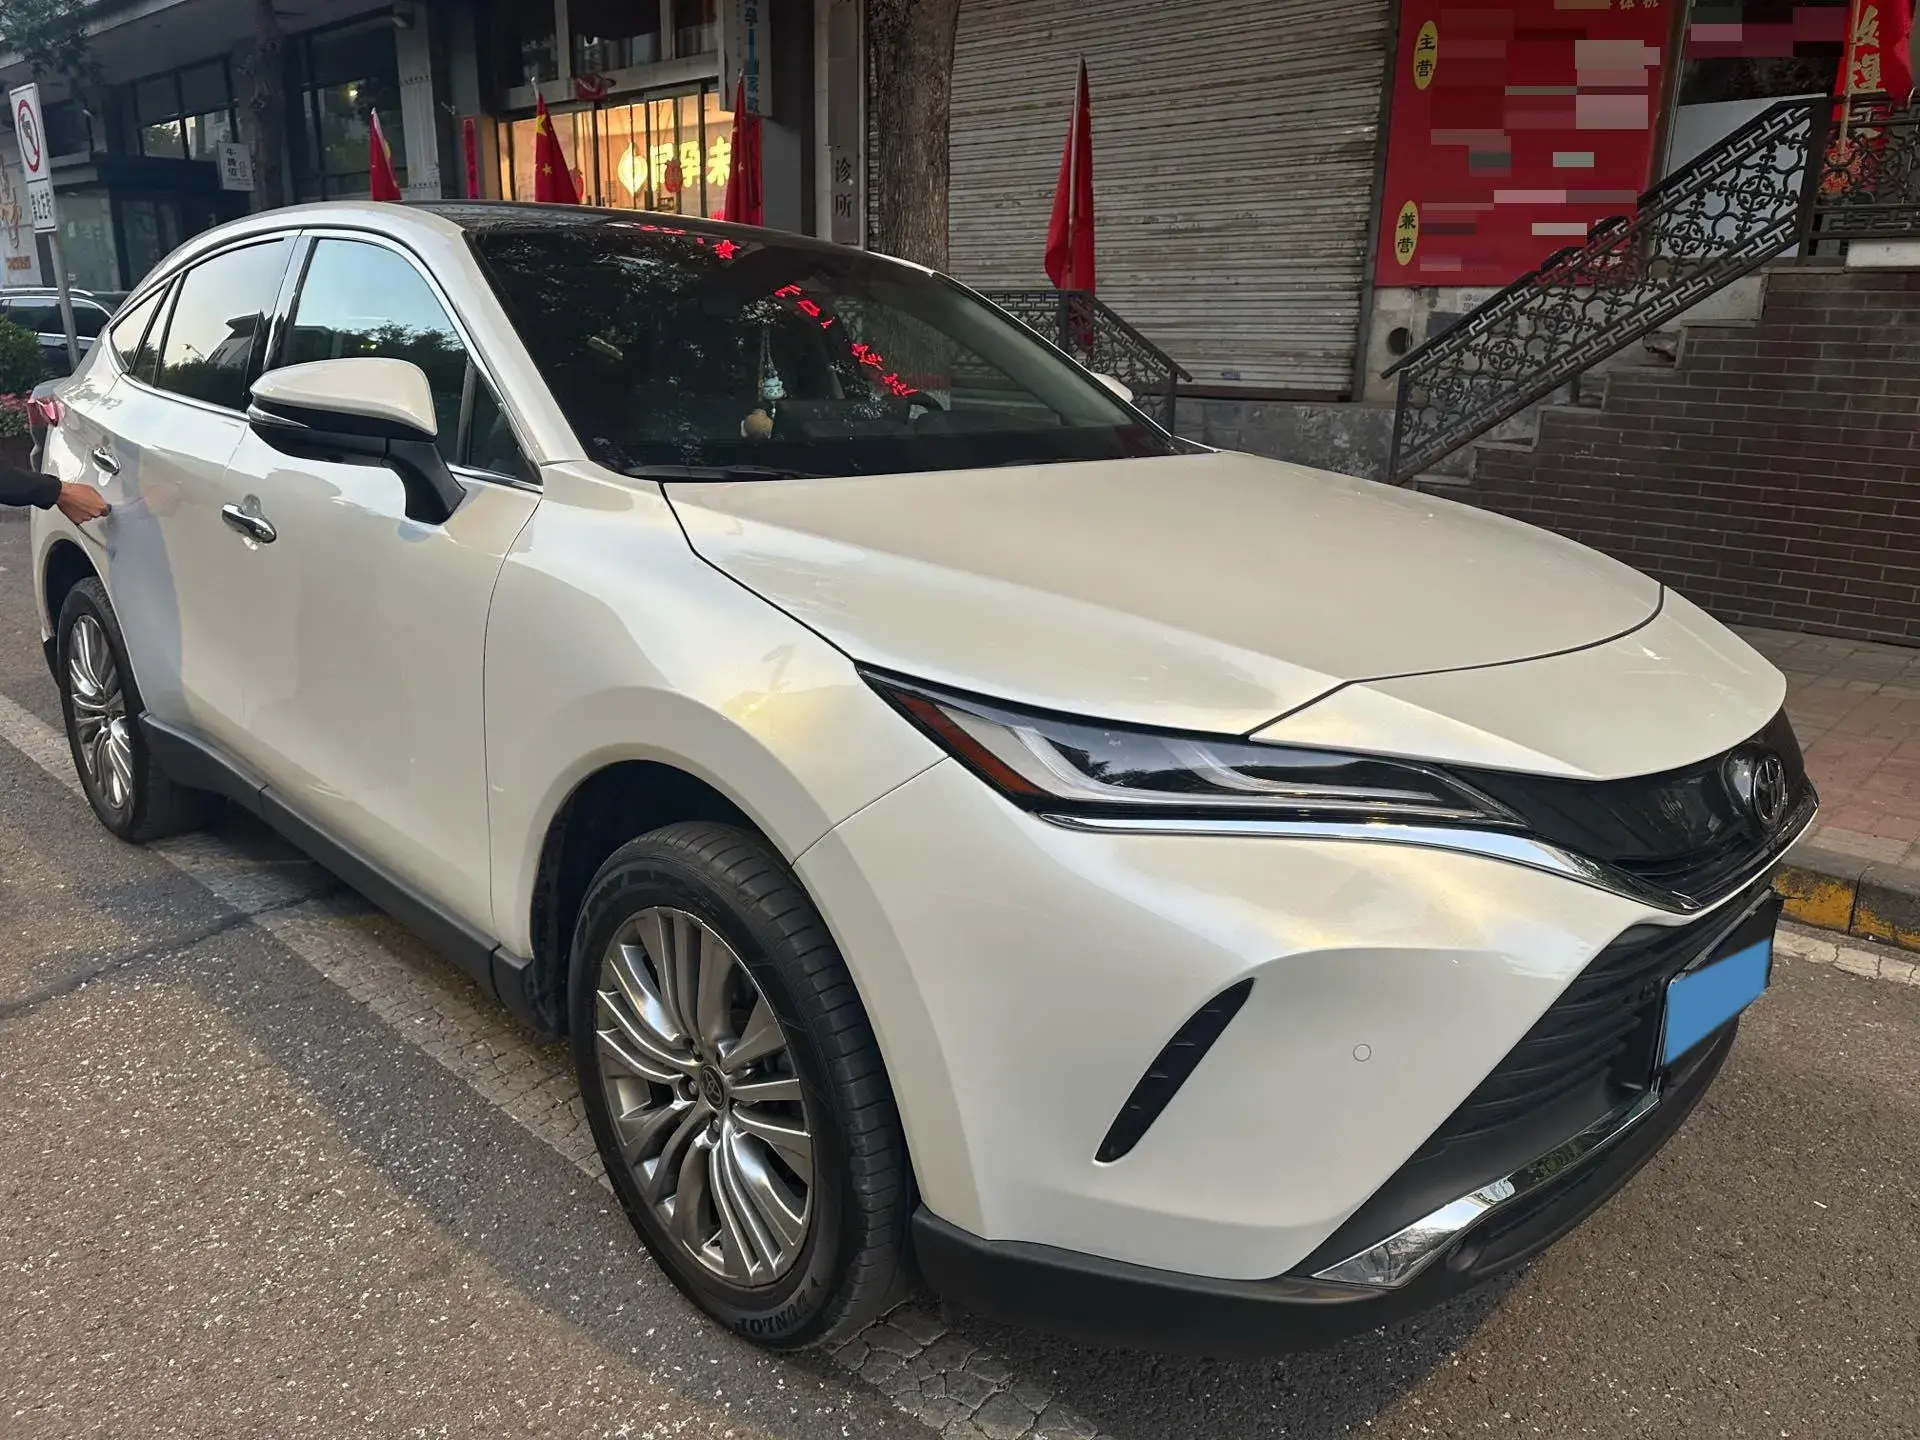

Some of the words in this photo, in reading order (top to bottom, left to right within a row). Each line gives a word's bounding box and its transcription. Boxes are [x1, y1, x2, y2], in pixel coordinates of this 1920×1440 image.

[1417, 33, 1436, 77] 主营
[834, 157, 853, 219] 诊所
[1397, 212, 1416, 253] 兼营
[736, 1290, 810, 1335] DUNLOP
